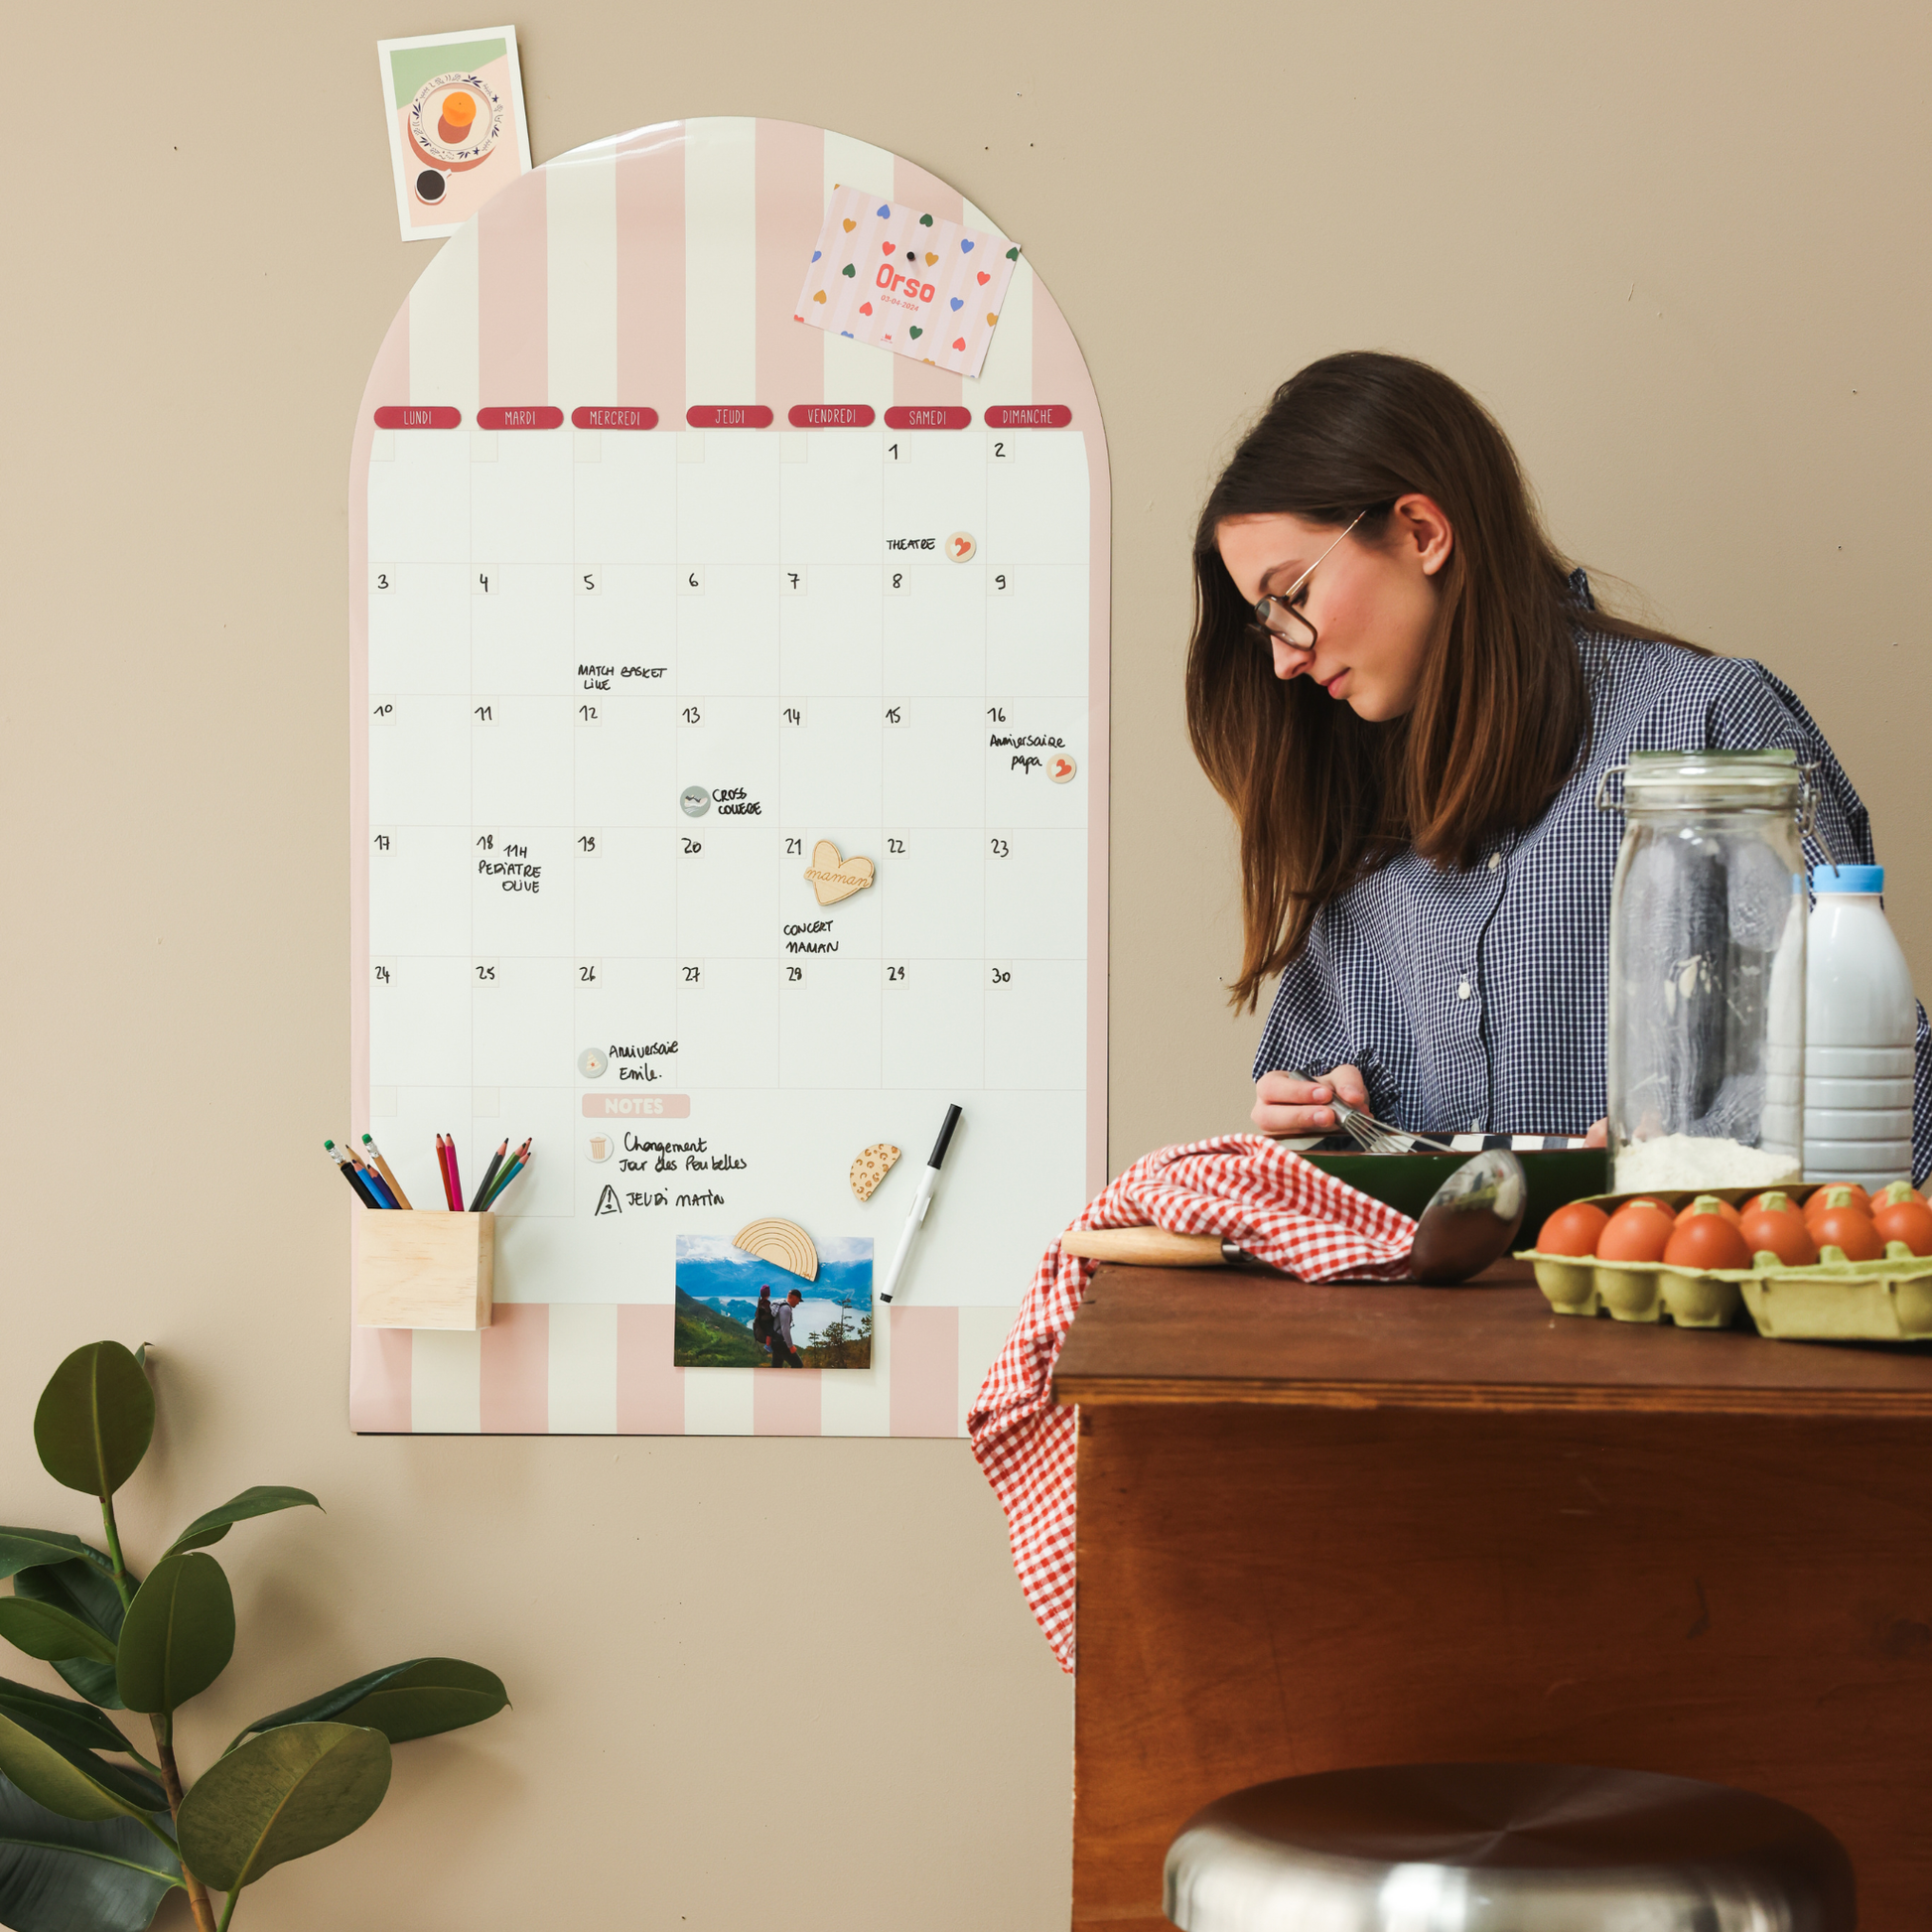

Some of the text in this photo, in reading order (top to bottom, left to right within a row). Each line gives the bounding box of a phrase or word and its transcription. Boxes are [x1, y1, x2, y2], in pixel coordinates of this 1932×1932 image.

[876, 263, 935, 304] Orso
[880, 294, 920, 312] 03-04-2024
[403, 410, 433, 426] LUNDI
[504, 410, 537, 426] MARDI
[589, 410, 641, 427] MERCREDI
[715, 408, 746, 425] JEUDI
[807, 408, 857, 425] VENDREDI
[908, 410, 947, 427] SAMEDI
[1002, 408, 1053, 425] DIMANCHE
[888, 443, 898, 461] 1
[994, 442, 1006, 458] 2
[377, 574, 389, 590] 3
[479, 573, 489, 593] 4
[583, 574, 595, 591] 5
[688, 572, 699, 588] 6
[787, 572, 800, 590] 7
[893, 573, 903, 589] 8
[995, 574, 1007, 591] 9
[577, 663, 668, 679] MATCH BASKET
[373, 704, 393, 717] 10
[474, 705, 492, 722] 11
[579, 705, 599, 722] 12
[681, 706, 701, 724] 13
[782, 708, 801, 726] 14
[885, 706, 901, 724] 15
[987, 707, 1007, 723] 16
[1011, 755, 1043, 775] papa
[712, 786, 748, 803] CROSS
[373, 834, 390, 851] 17
[476, 834, 494, 852] 18
[577, 835, 596, 853] 19
[681, 837, 702, 855] 20
[784, 837, 802, 856] 21
[887, 838, 906, 854] 22
[990, 838, 1010, 858] 23
[502, 843, 528, 860] 11H
[805, 868, 871, 888] maman
[782, 919, 834, 936] CONCERT
[785, 940, 840, 954] MAMAN
[374, 965, 391, 985] 24
[475, 965, 495, 981] 25
[579, 965, 597, 982] 26
[681, 966, 701, 983] 27
[785, 966, 803, 982] 28
[887, 966, 905, 982] 29
[992, 967, 1012, 984] 30
[605, 1098, 664, 1114] NOTES
